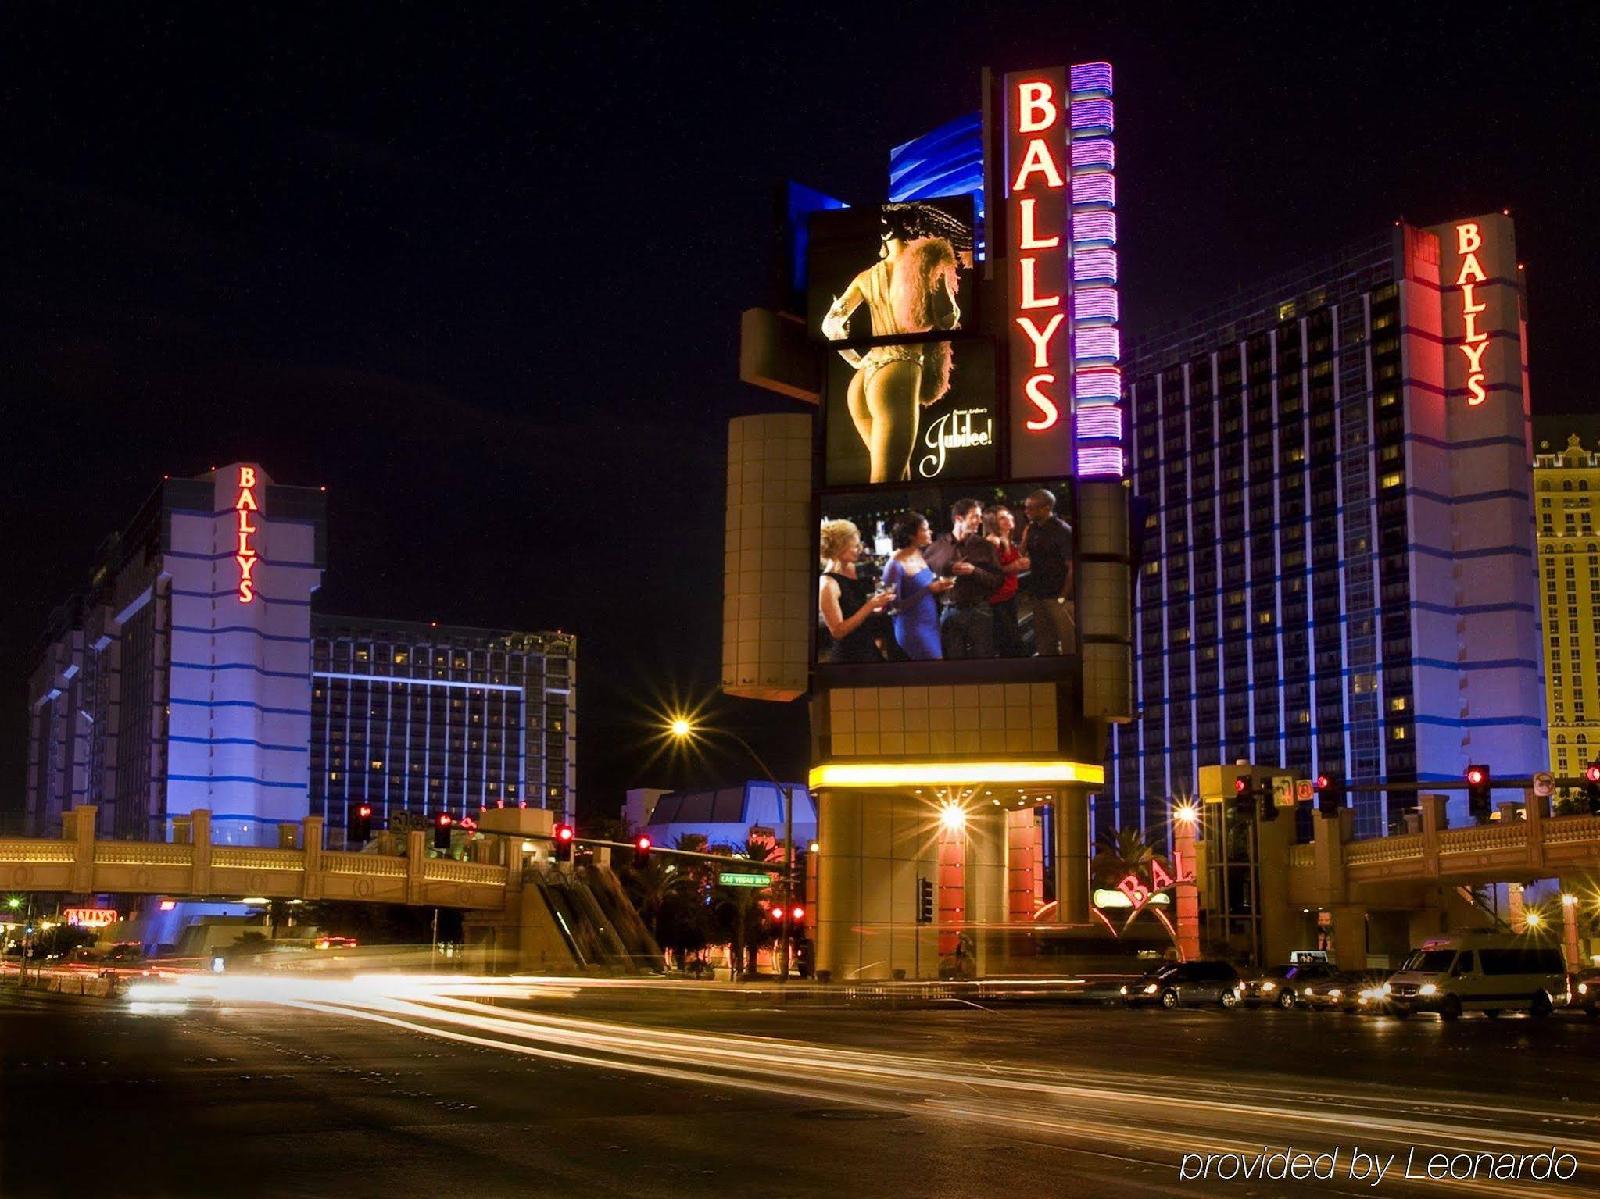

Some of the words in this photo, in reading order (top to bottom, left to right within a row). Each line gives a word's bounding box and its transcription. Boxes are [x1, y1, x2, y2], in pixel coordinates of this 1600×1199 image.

[1012, 81, 1064, 431] BALLYS
[1455, 222, 1489, 406] BALLYS
[918, 412, 993, 478] Jubilee!
[235, 466, 258, 603] BALLYS
